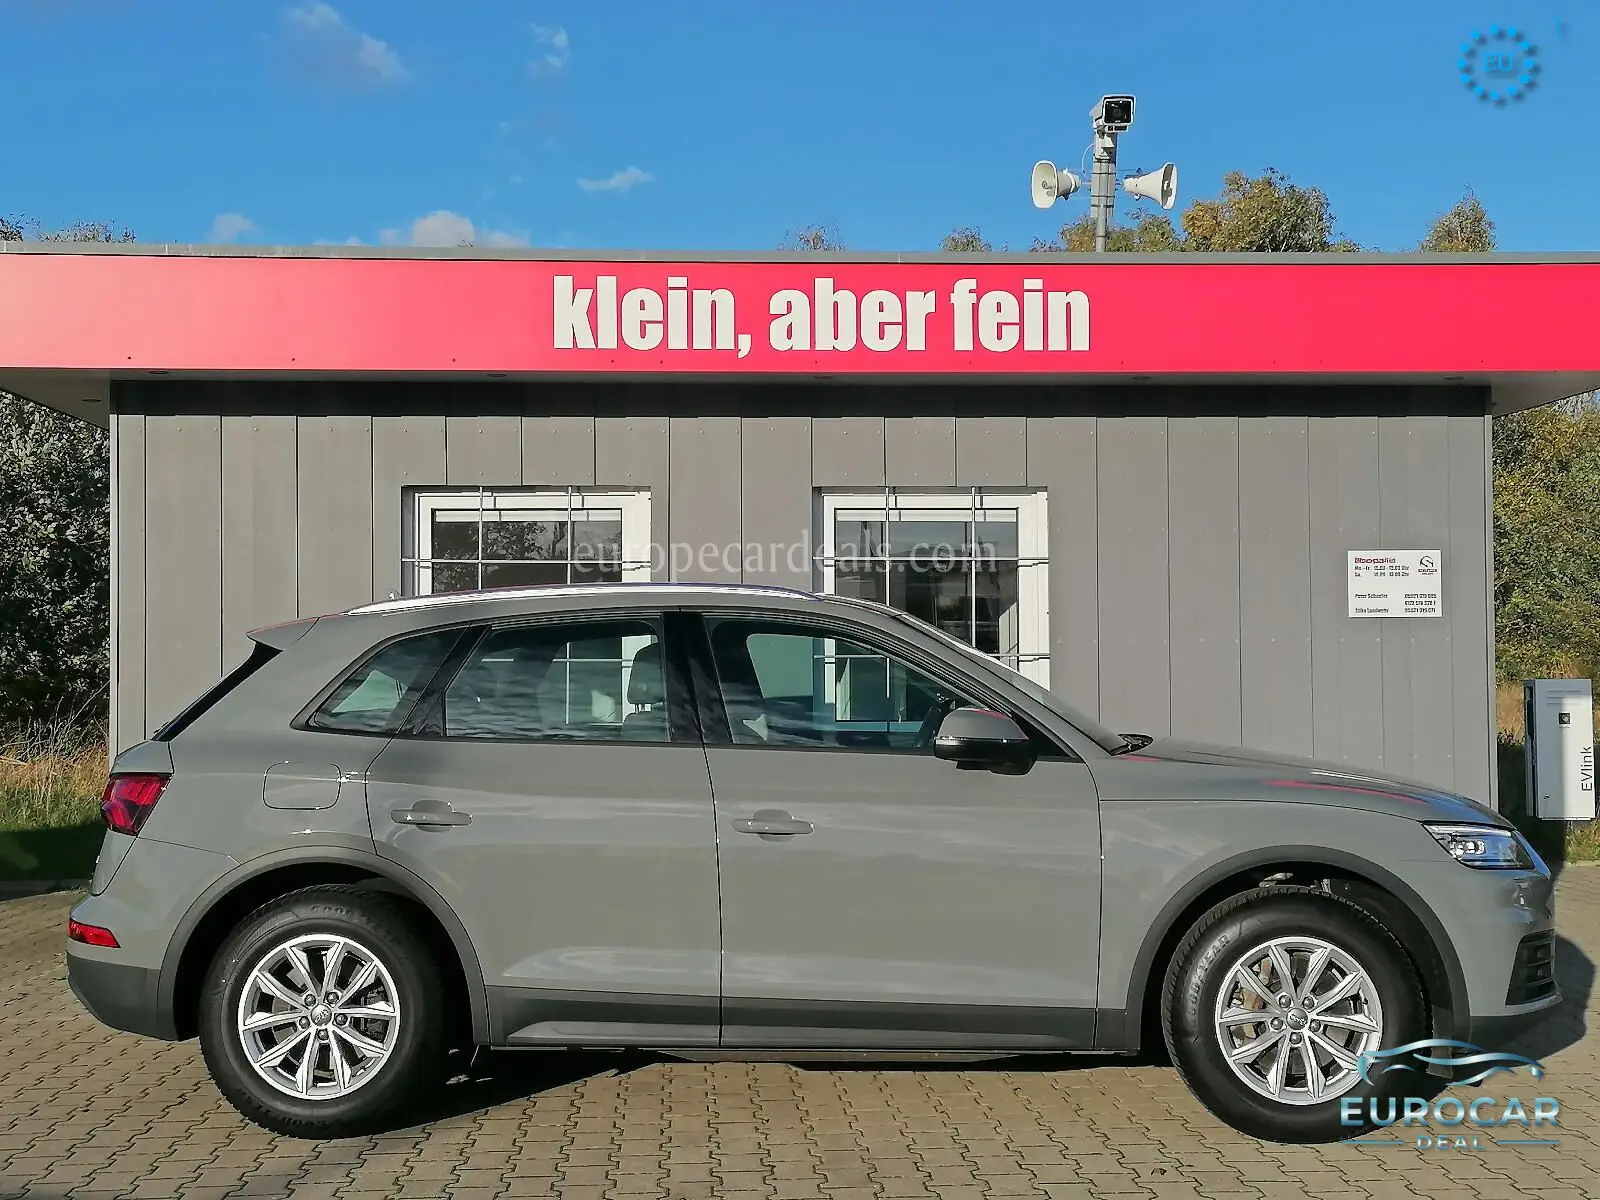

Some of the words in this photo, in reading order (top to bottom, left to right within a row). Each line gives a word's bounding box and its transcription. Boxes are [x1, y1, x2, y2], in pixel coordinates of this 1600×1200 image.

[553, 275, 751, 359] klein,
[769, 277, 936, 353] aber
[949, 278, 1090, 353] fein
[1580, 746, 1592, 792] EVlink
